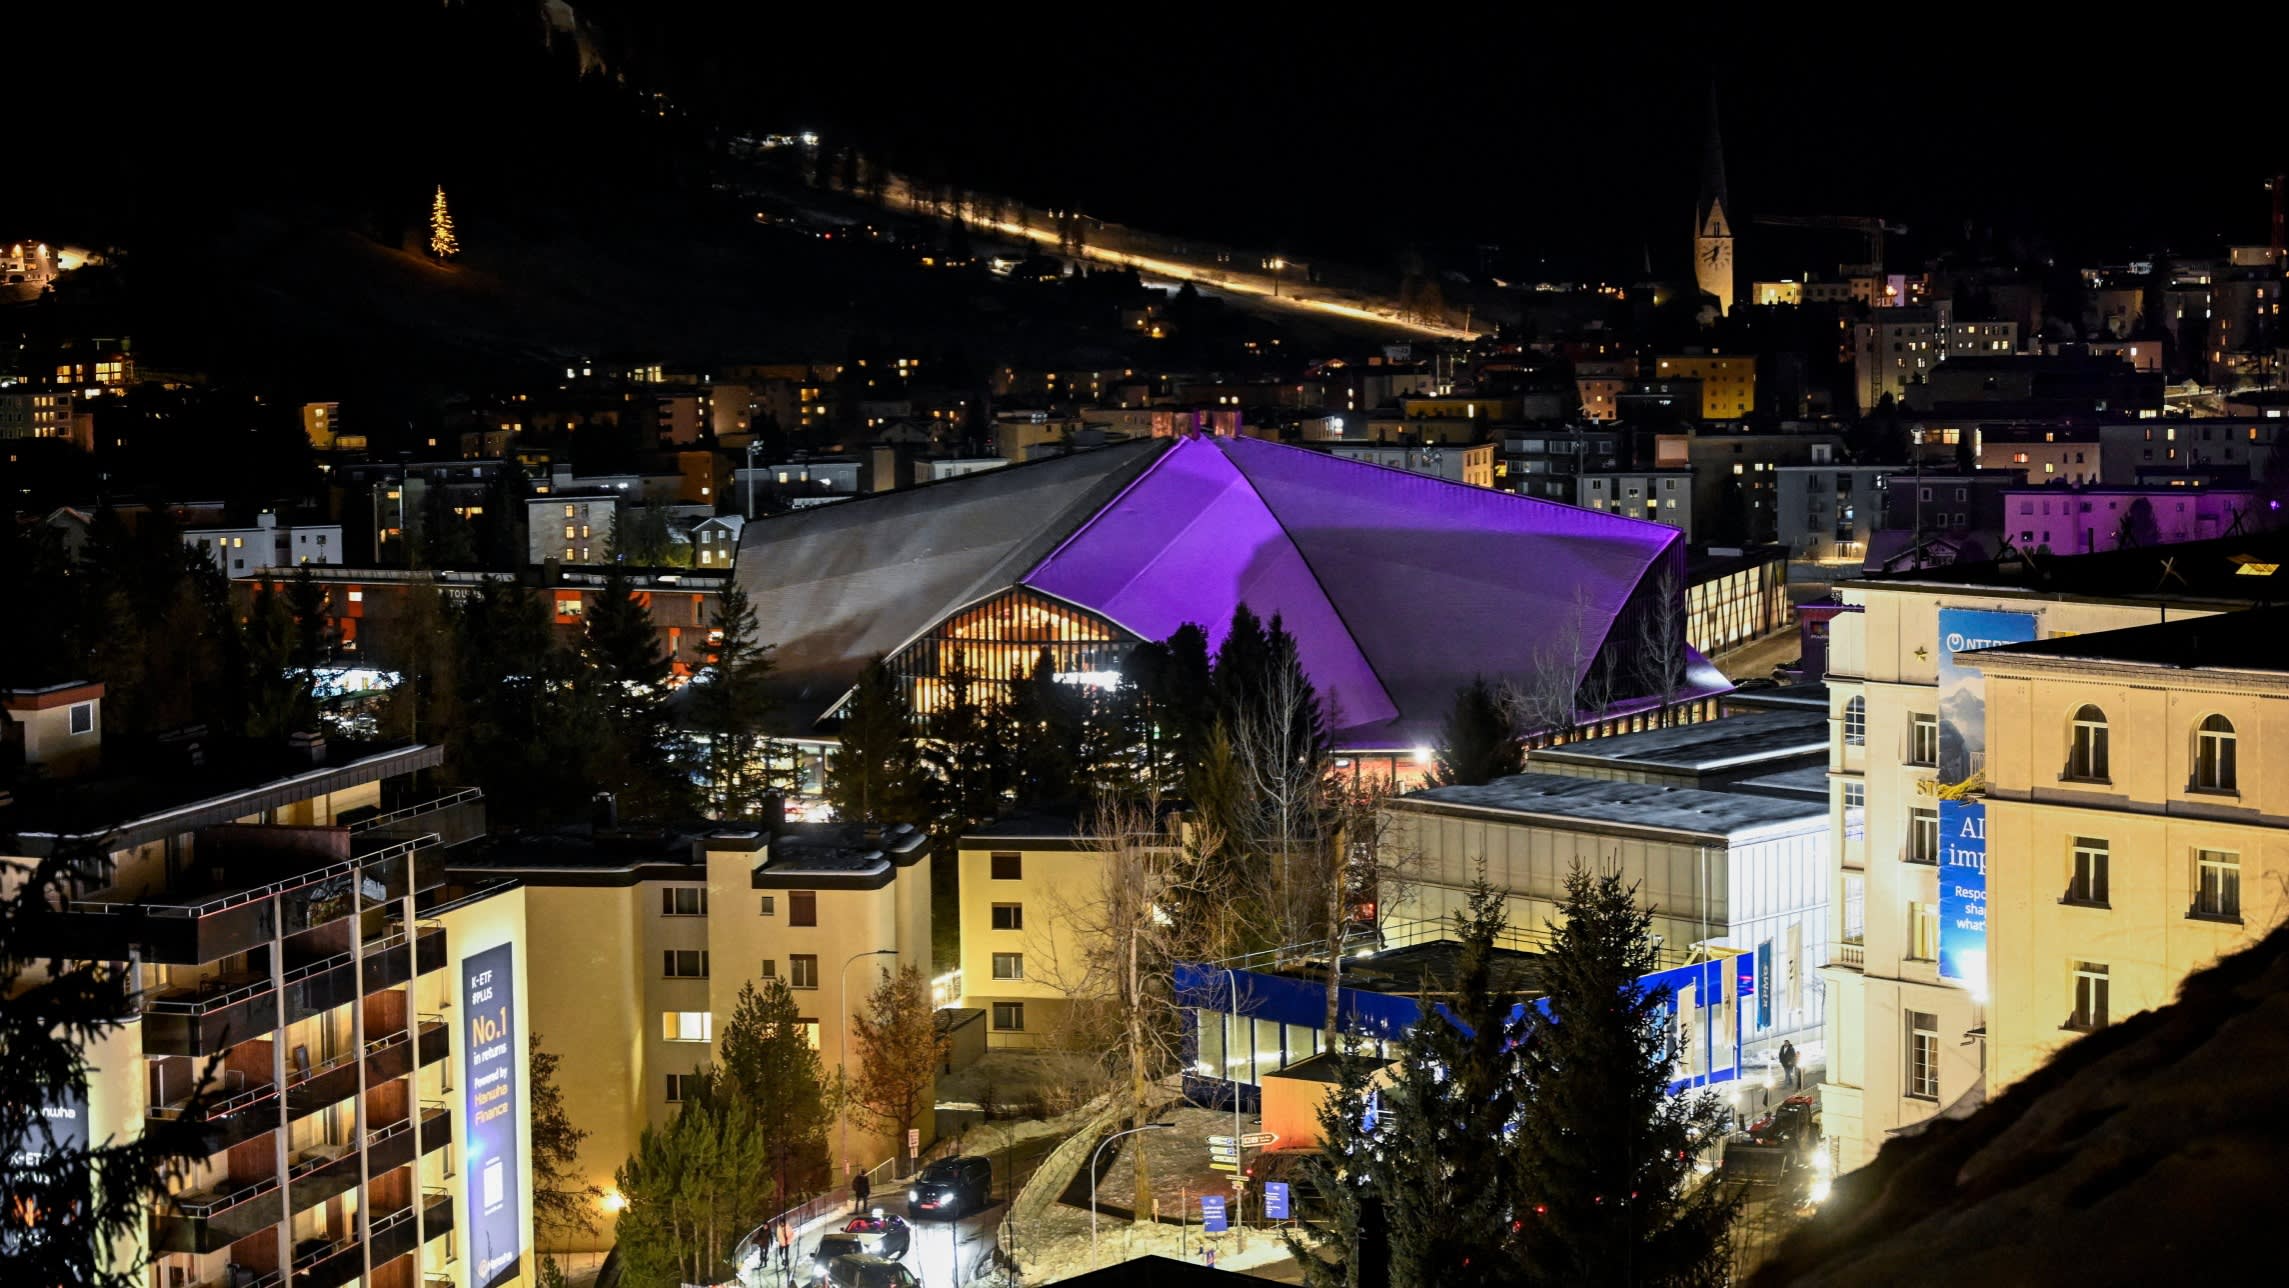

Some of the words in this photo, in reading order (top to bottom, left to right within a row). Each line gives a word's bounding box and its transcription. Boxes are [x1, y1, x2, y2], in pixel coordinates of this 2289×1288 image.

[1965, 903, 1986, 918] sha
[471, 970, 492, 988] K-ETF
[472, 1006, 507, 1048] No.1
[473, 1051, 482, 1066] in
[25, 1105, 76, 1118] nwha
[475, 1102, 509, 1127] Finance
